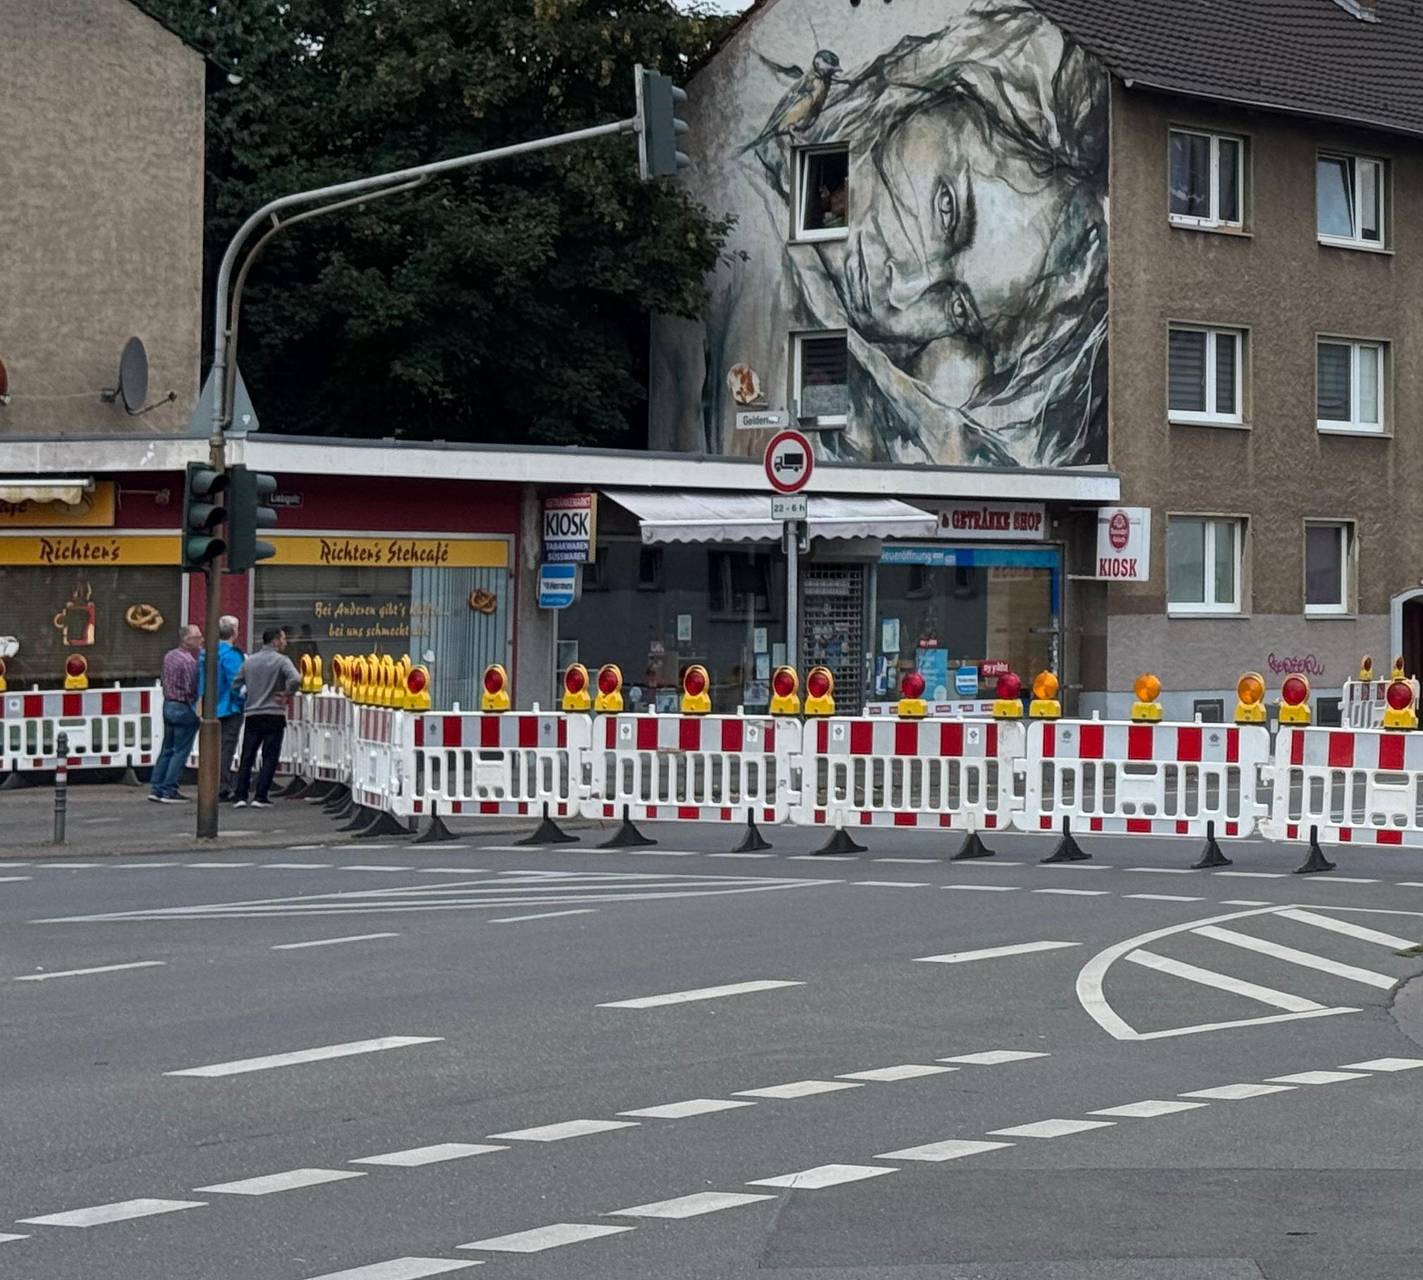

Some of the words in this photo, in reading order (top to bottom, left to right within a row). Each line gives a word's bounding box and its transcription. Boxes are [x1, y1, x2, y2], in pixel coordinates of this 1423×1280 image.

[774, 504, 784, 513] 22
[792, 504, 797, 512] 6
[799, 503, 805, 512] h
[952, 506, 1010, 531] GETRÄNKE
[1013, 512, 1042, 532] SHOP
[545, 512, 590, 537] KIOSK
[40, 537, 121, 563] Richter's
[320, 538, 382, 564] Richter's
[387, 539, 449, 565] Stehcafé
[1099, 557, 1138, 578] KIOSK
[314, 601, 331, 617] Bei
[334, 601, 376, 619] Anderen
[328, 623, 345, 638] bei
[346, 627, 363, 638] uns
[366, 622, 409, 638] schmeckt
